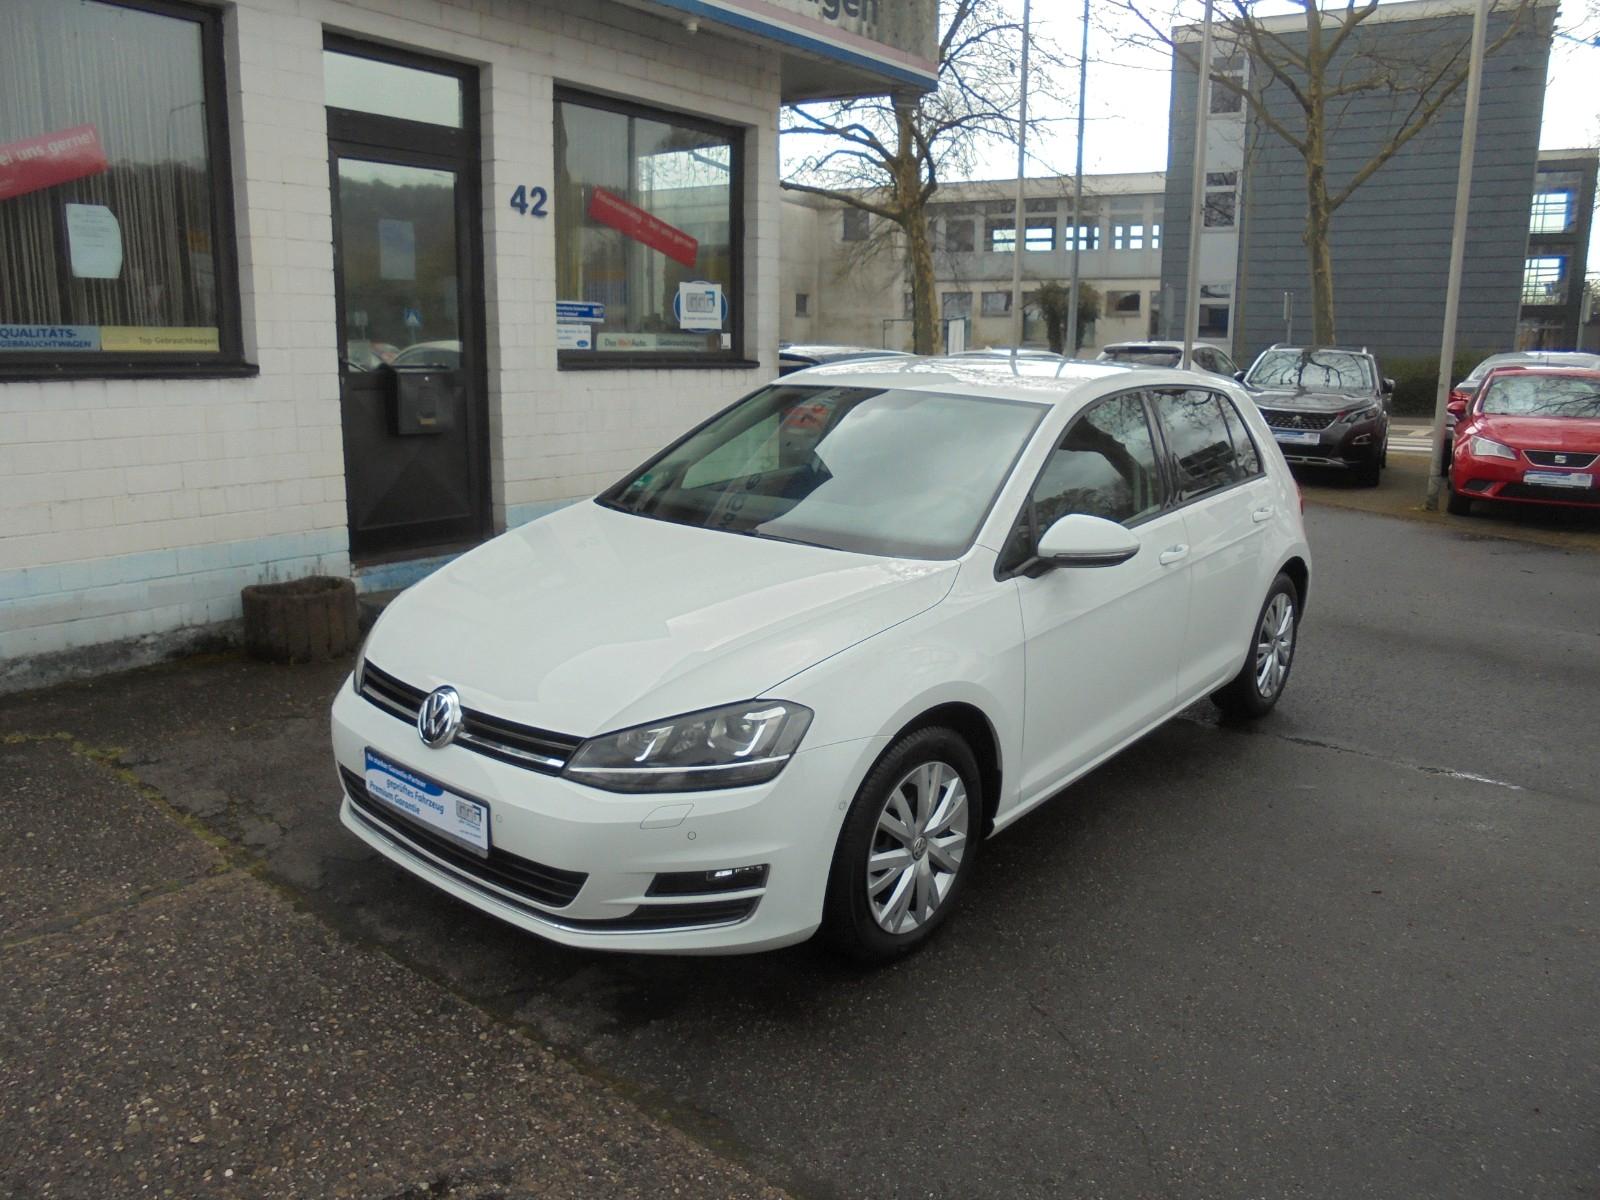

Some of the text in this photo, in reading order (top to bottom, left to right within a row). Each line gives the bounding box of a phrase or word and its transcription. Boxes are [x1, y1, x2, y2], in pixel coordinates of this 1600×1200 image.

[16, 145, 45, 160] uns
[47, 128, 97, 156] gerne!
[510, 185, 548, 217] 42
[0, 326, 77, 338] QUALITÄTS-
[0, 339, 92, 348] GEBRAUCHTWAGEN
[369, 780, 394, 800] Premium
[415, 790, 445, 815] Fahrzeug
